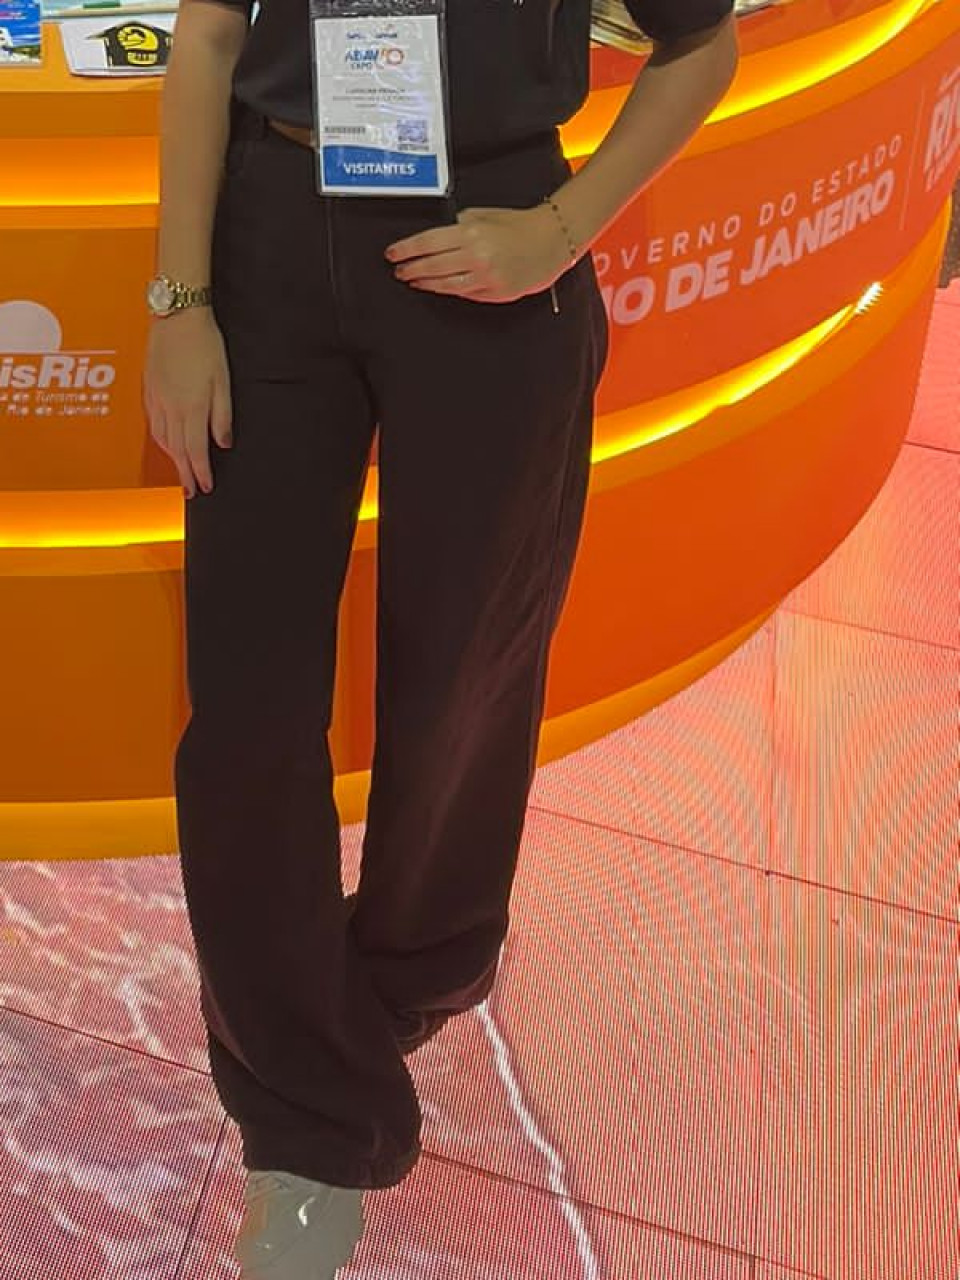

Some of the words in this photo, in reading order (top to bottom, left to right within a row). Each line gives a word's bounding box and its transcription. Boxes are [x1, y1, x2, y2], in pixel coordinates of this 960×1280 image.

[344, 162, 416, 176] VISITANTES
[593, 215, 741, 276] OVERNO
[759, 192, 797, 227] DO
[812, 134, 902, 205] ESTADO
[601, 276, 656, 327] IO
[664, 250, 734, 313] DE
[741, 171, 895, 286] JANEIRO
[35, 389, 88, 402] Turismo
